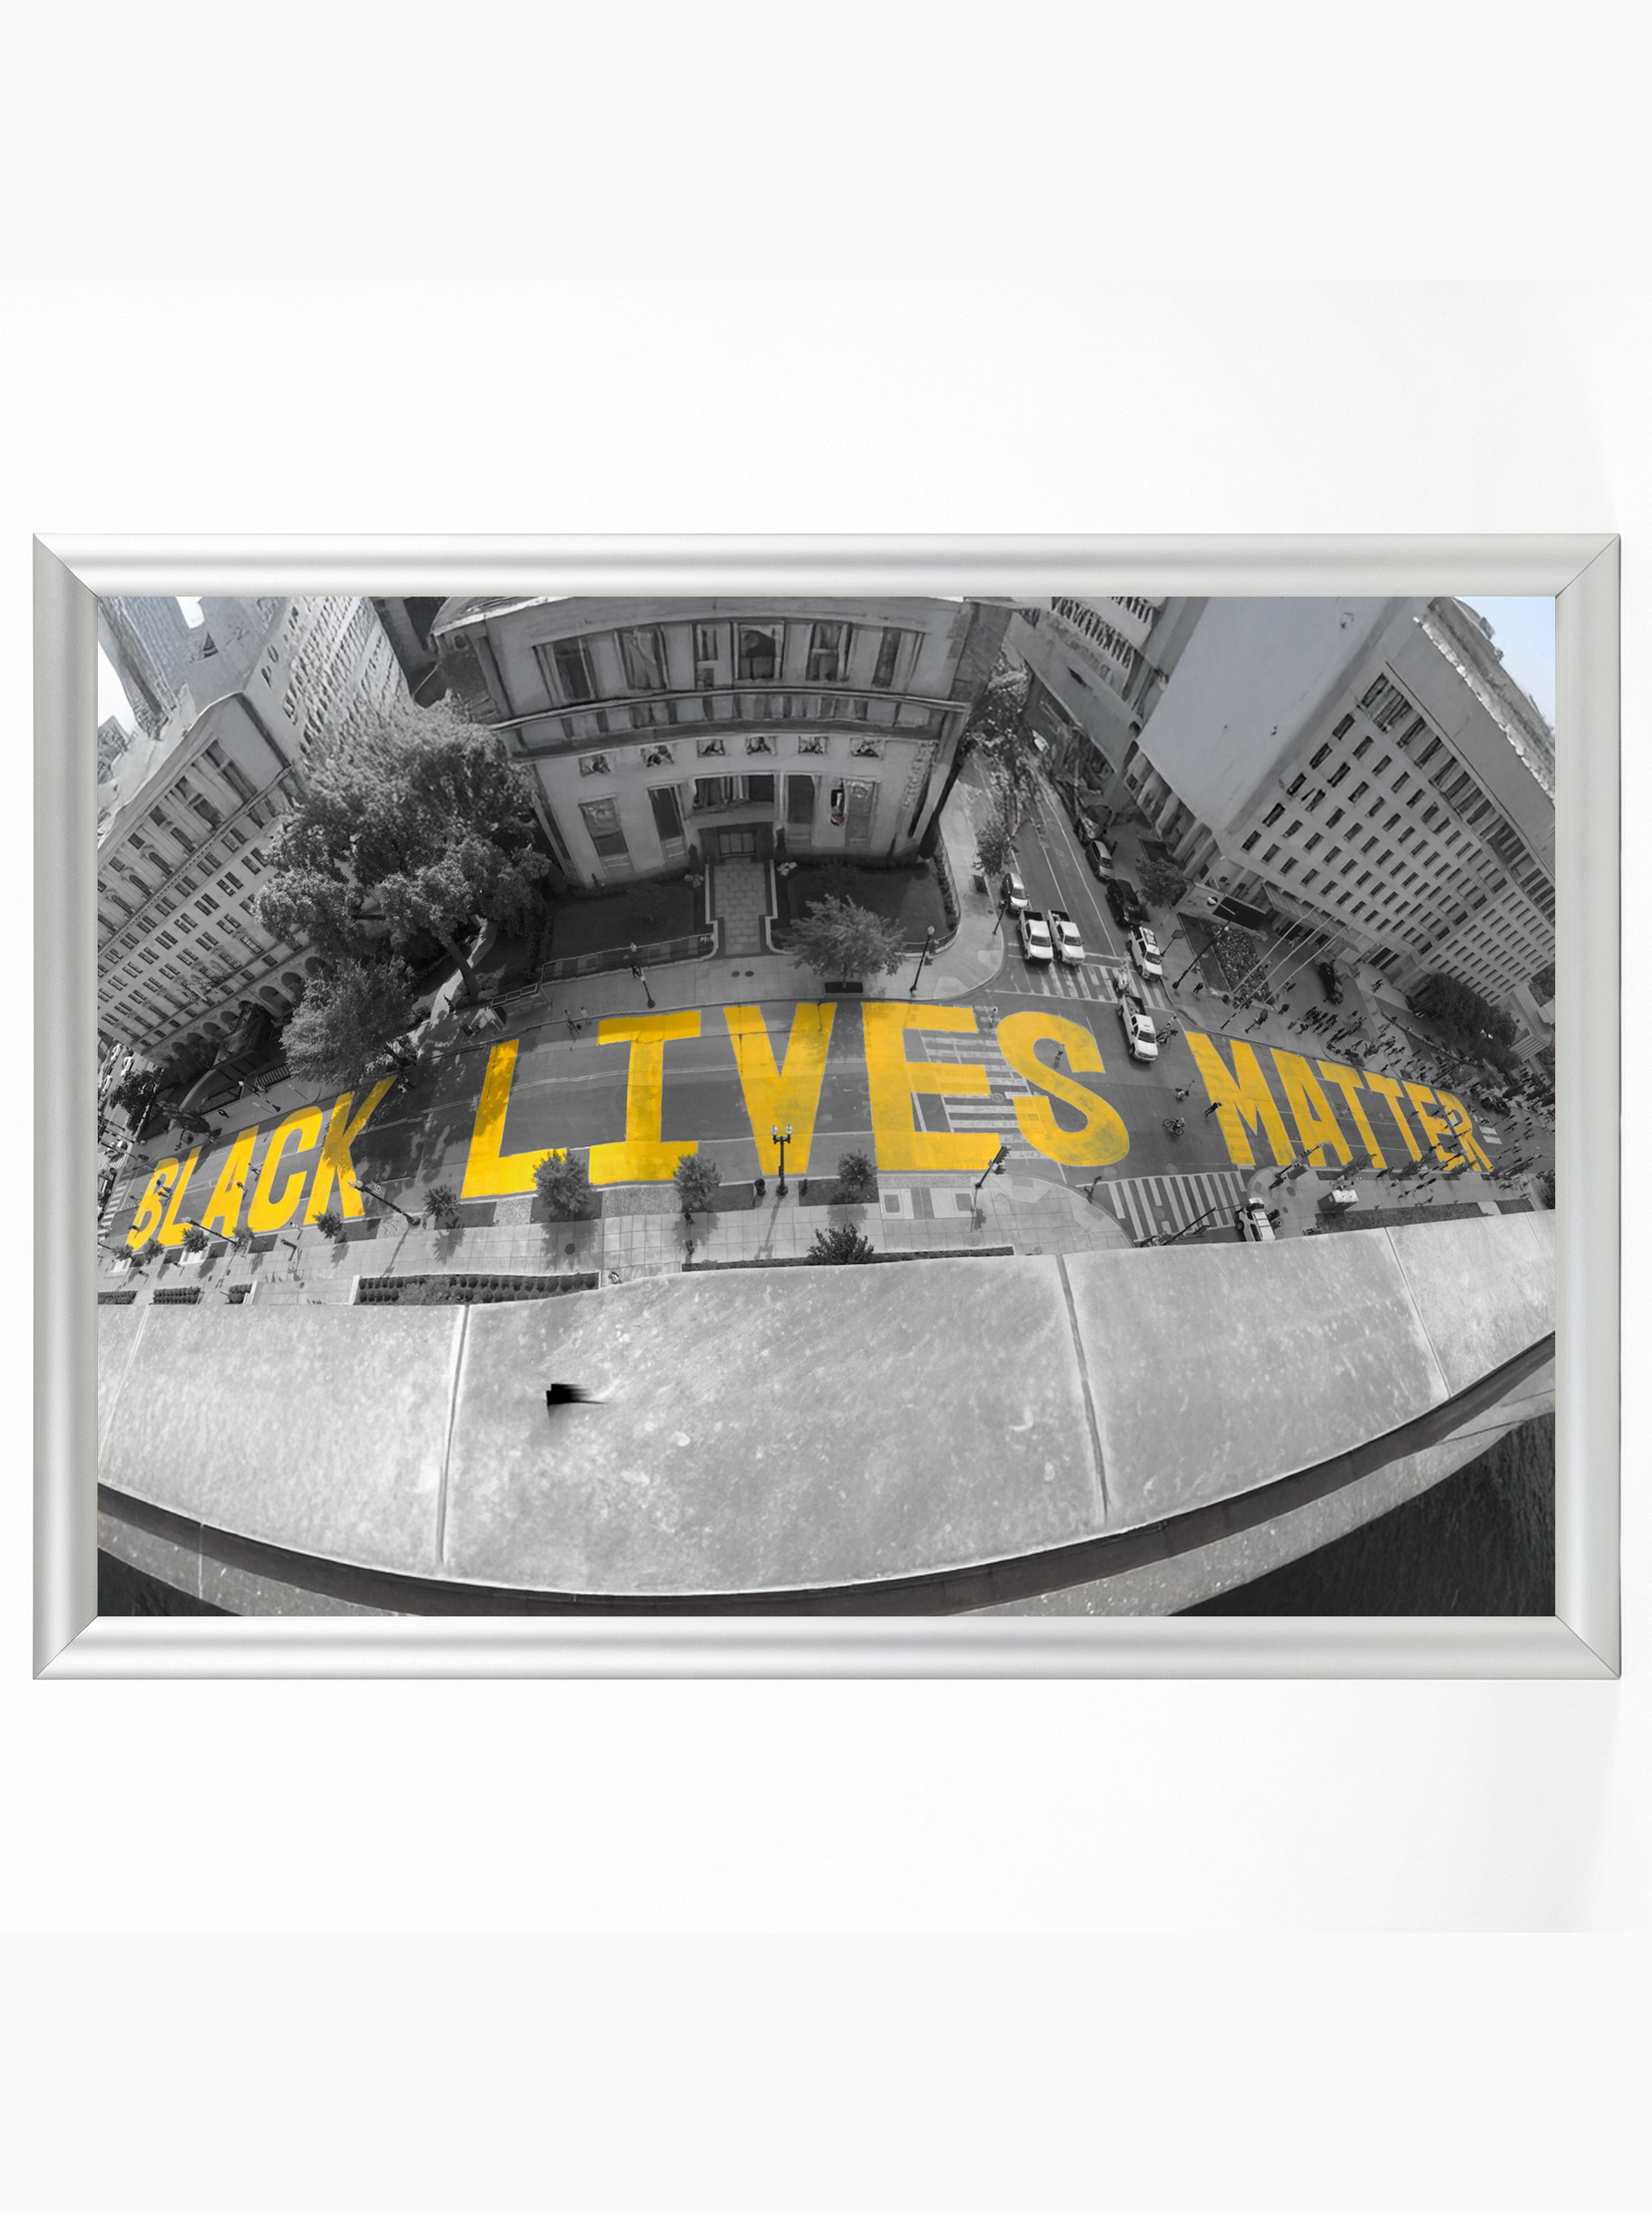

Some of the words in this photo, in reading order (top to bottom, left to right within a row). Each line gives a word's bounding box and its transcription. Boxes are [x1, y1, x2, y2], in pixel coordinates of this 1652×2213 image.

[126, 1077, 395, 1251] BLACK
[461, 1002, 1130, 1199] LIVES
[1186, 1032, 1493, 1173] MATTER
